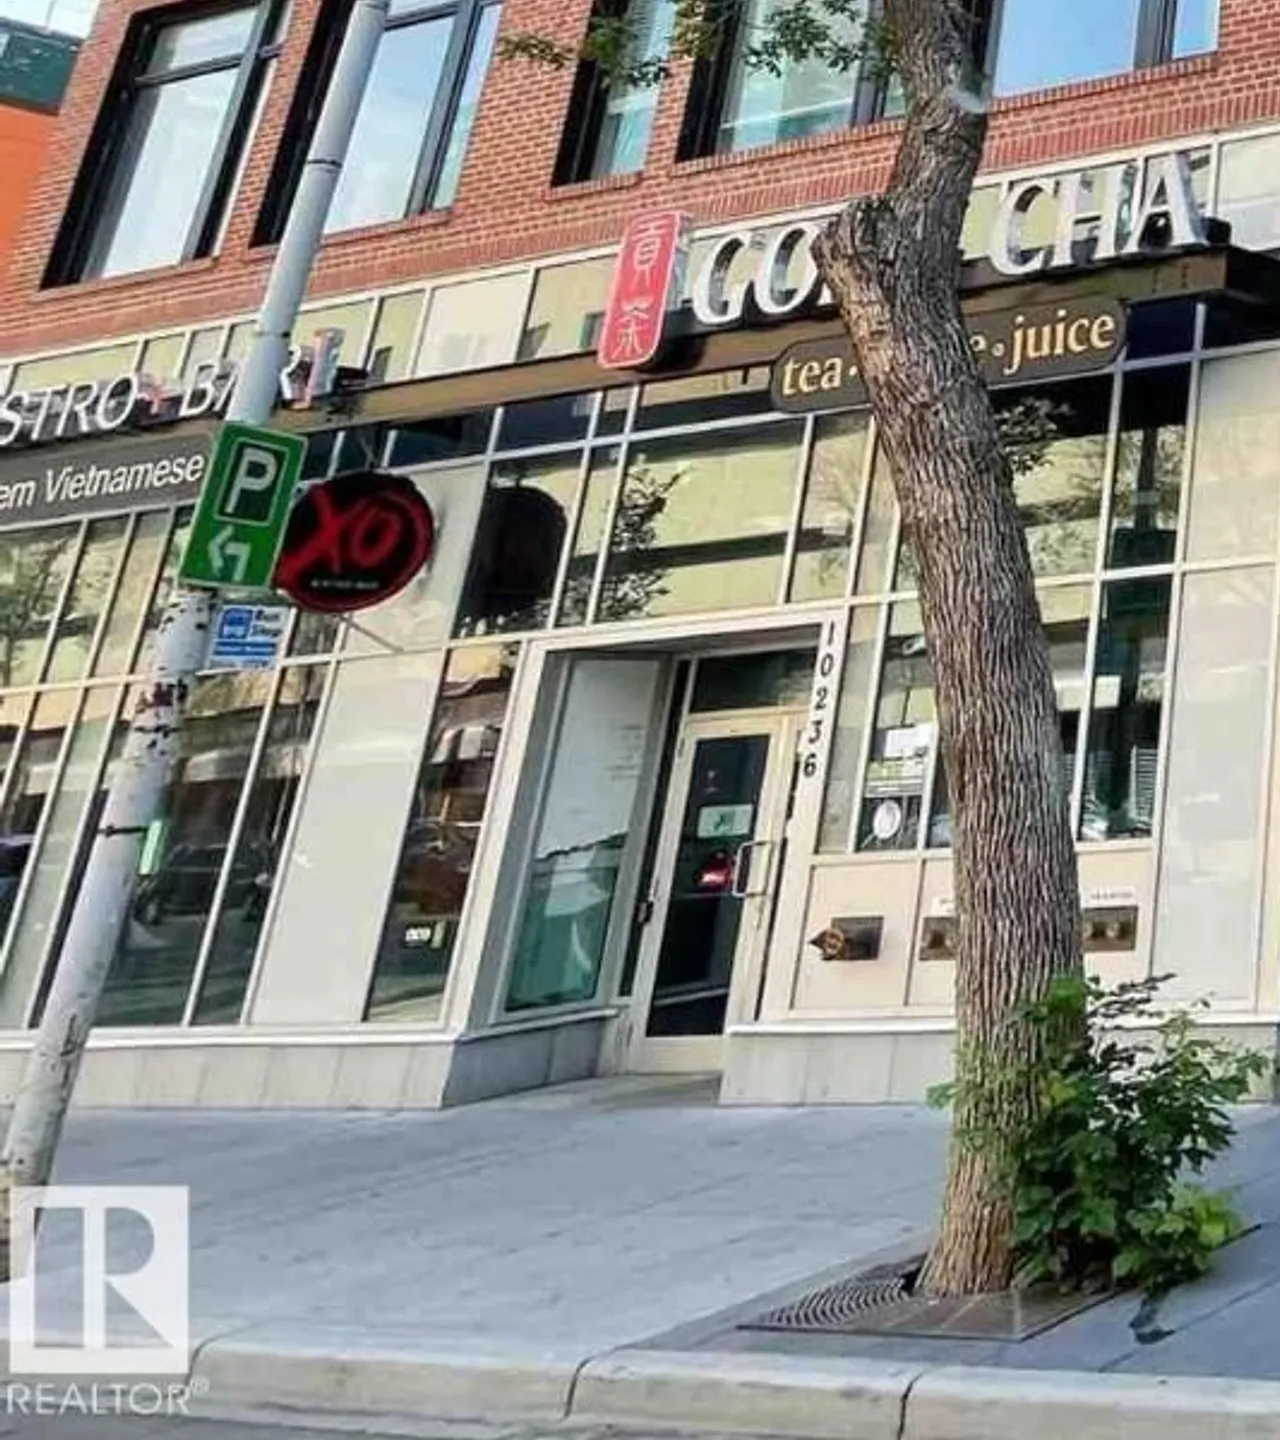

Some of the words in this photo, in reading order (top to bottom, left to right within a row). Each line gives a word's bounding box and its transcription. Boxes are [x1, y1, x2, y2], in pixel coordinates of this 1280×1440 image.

[988, 151, 1209, 275] CHA
[781, 356, 842, 398] tea
[1006, 308, 1115, 373] juice
[46, 453, 204, 503] Vietnamese
[224, 446, 278, 515] P
[275, 483, 401, 585] XO
[803, 619, 836, 778] 10236
